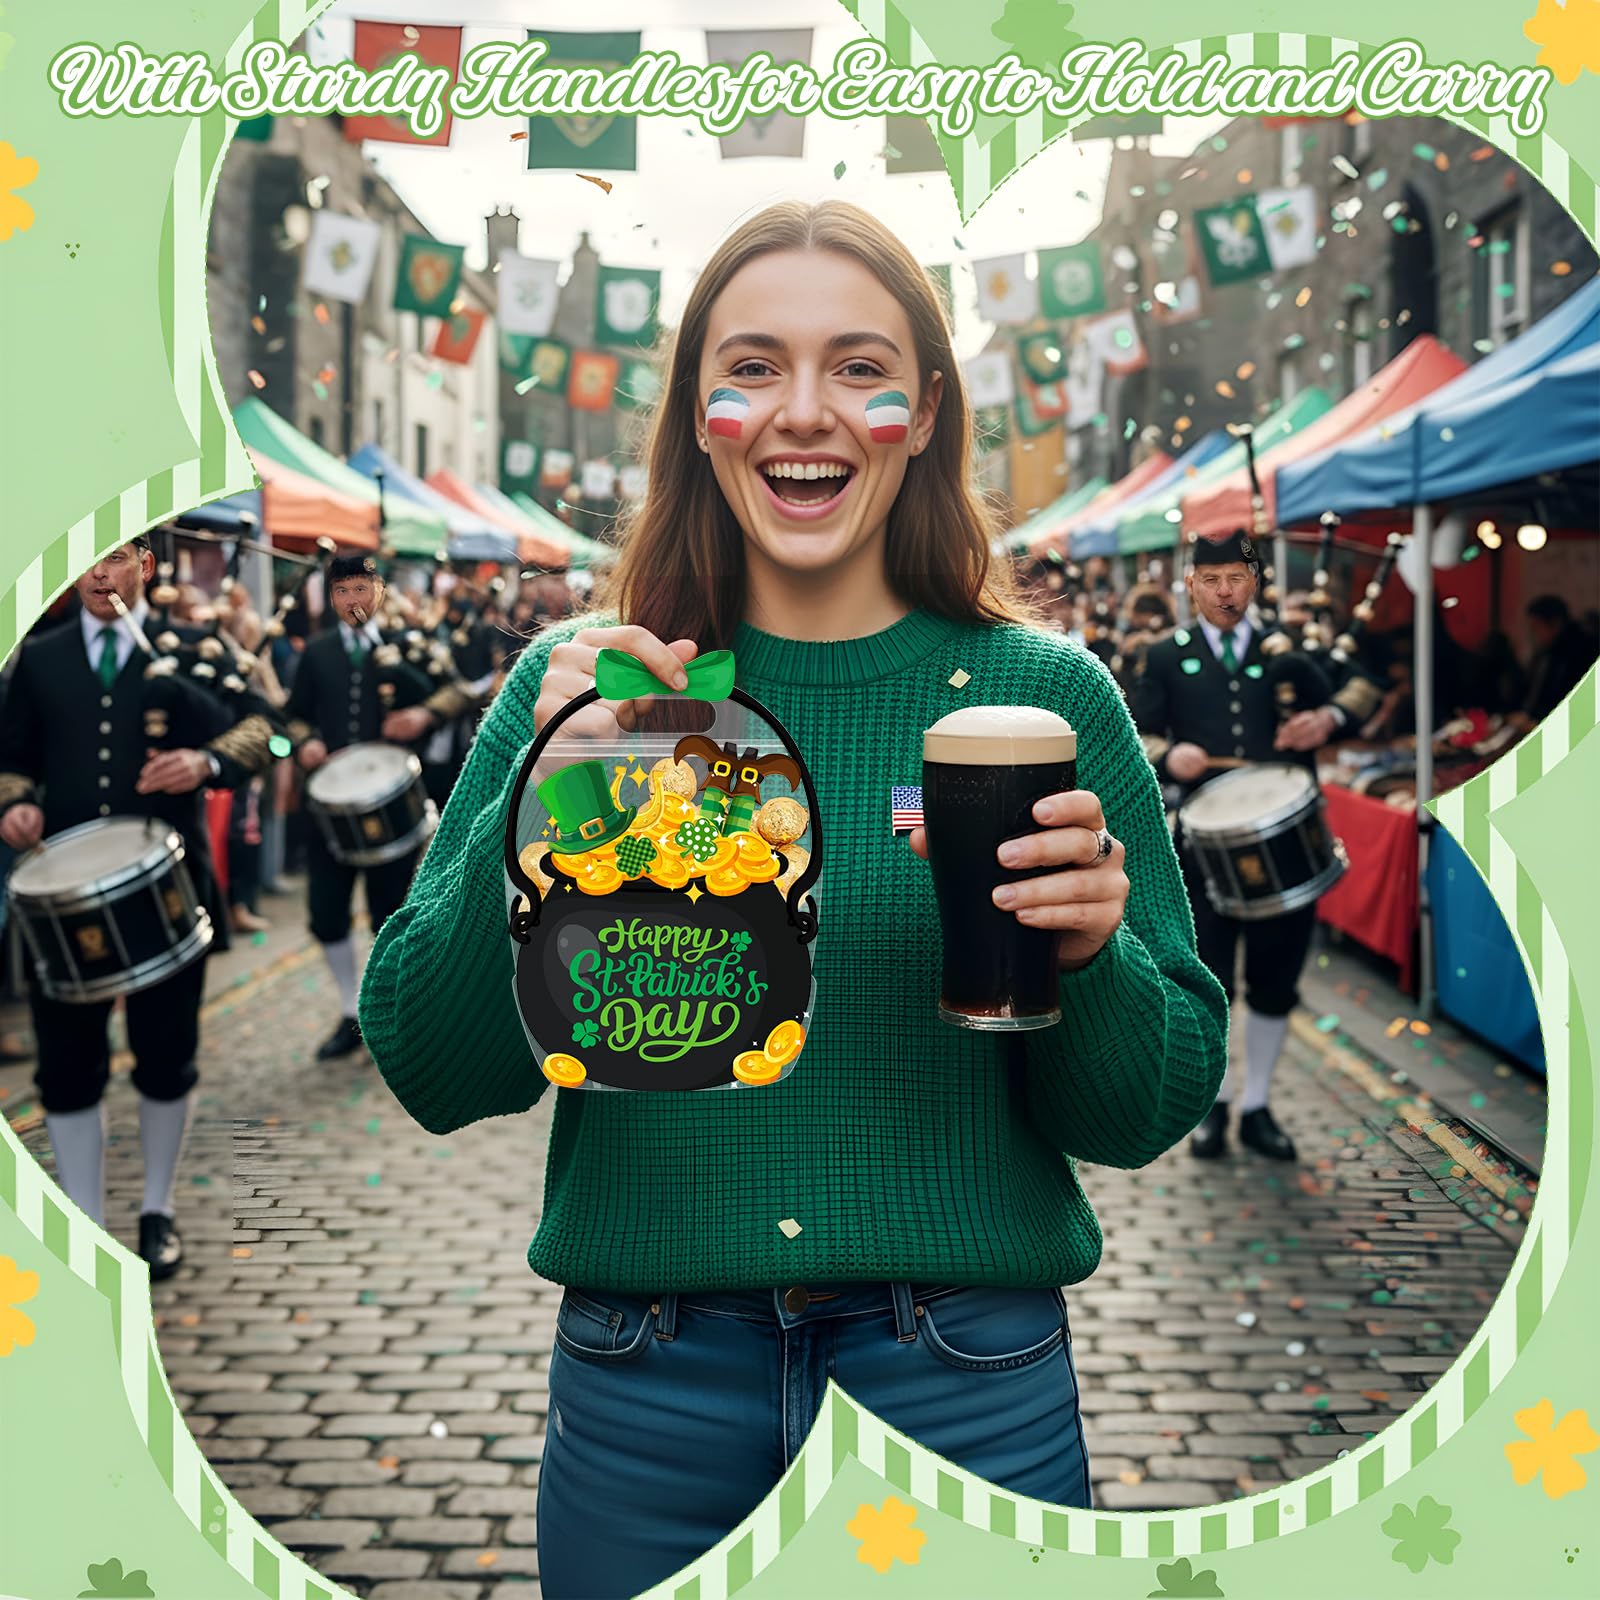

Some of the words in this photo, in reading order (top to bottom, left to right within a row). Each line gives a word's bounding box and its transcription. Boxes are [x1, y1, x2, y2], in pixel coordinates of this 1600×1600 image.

[598, 918, 728, 962] Happy
[569, 949, 626, 1013] St.
[625, 951, 768, 1005] Patrick's
[600, 998, 740, 1062] Day
